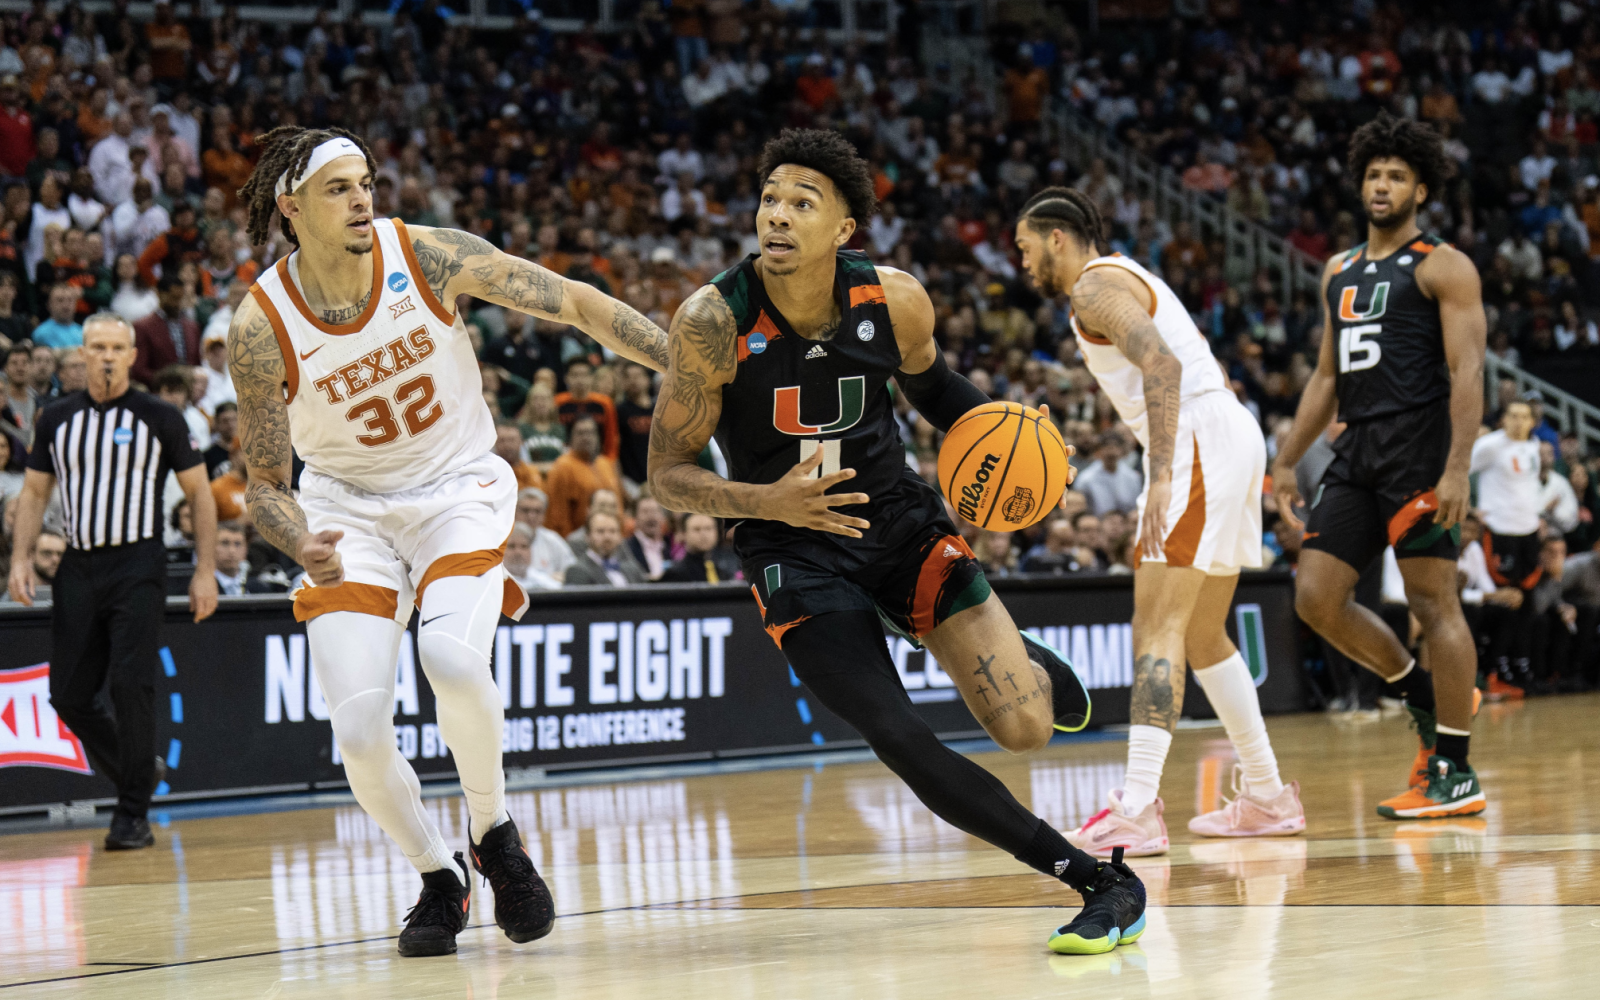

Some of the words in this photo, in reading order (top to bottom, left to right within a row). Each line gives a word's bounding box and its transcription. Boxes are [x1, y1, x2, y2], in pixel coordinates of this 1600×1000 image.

[392, 277, 407, 290] NCAA
[1338, 281, 1391, 322] U
[313, 324, 437, 405] TEXAS
[805, 350, 828, 360] adidas
[1339, 323, 1382, 374] 15
[345, 373, 446, 448] 32
[773, 375, 866, 436] U
[958, 453, 1001, 522] Wilson
[264, 630, 420, 724] NA
[495, 624, 575, 710] ITE
[588, 616, 733, 705] EIGHT
[536, 714, 560, 751] 12
[562, 707, 686, 749] CONFERENCE
